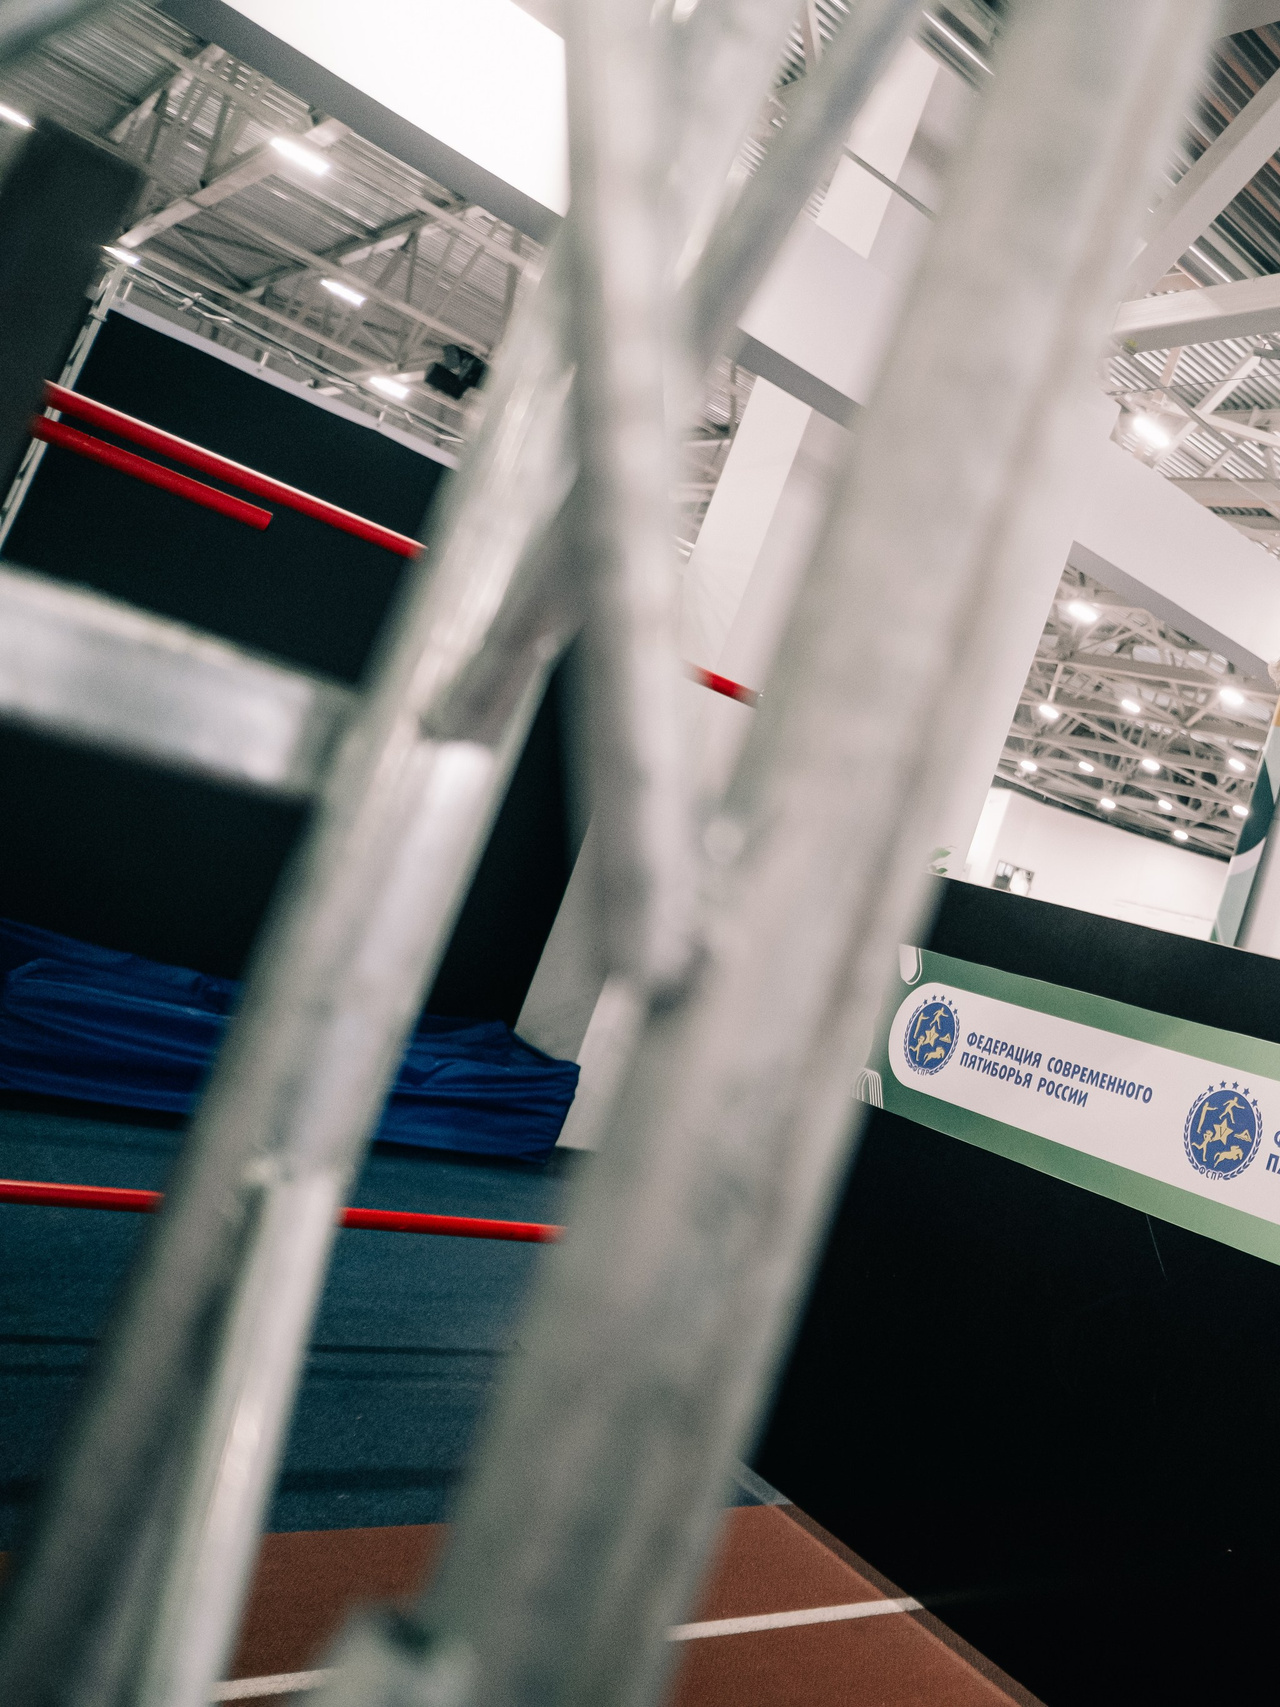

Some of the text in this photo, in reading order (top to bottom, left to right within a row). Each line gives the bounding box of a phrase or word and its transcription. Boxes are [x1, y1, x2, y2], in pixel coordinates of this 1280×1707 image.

[959, 1052, 1089, 1108] ПЯТИБОРЬЯ РОССИИ
[966, 1032, 1153, 1104] ФЕДЕРАЦИЯ СОВРЕМЕННОГО
[1199, 1166, 1223, 1181] ФСПР
